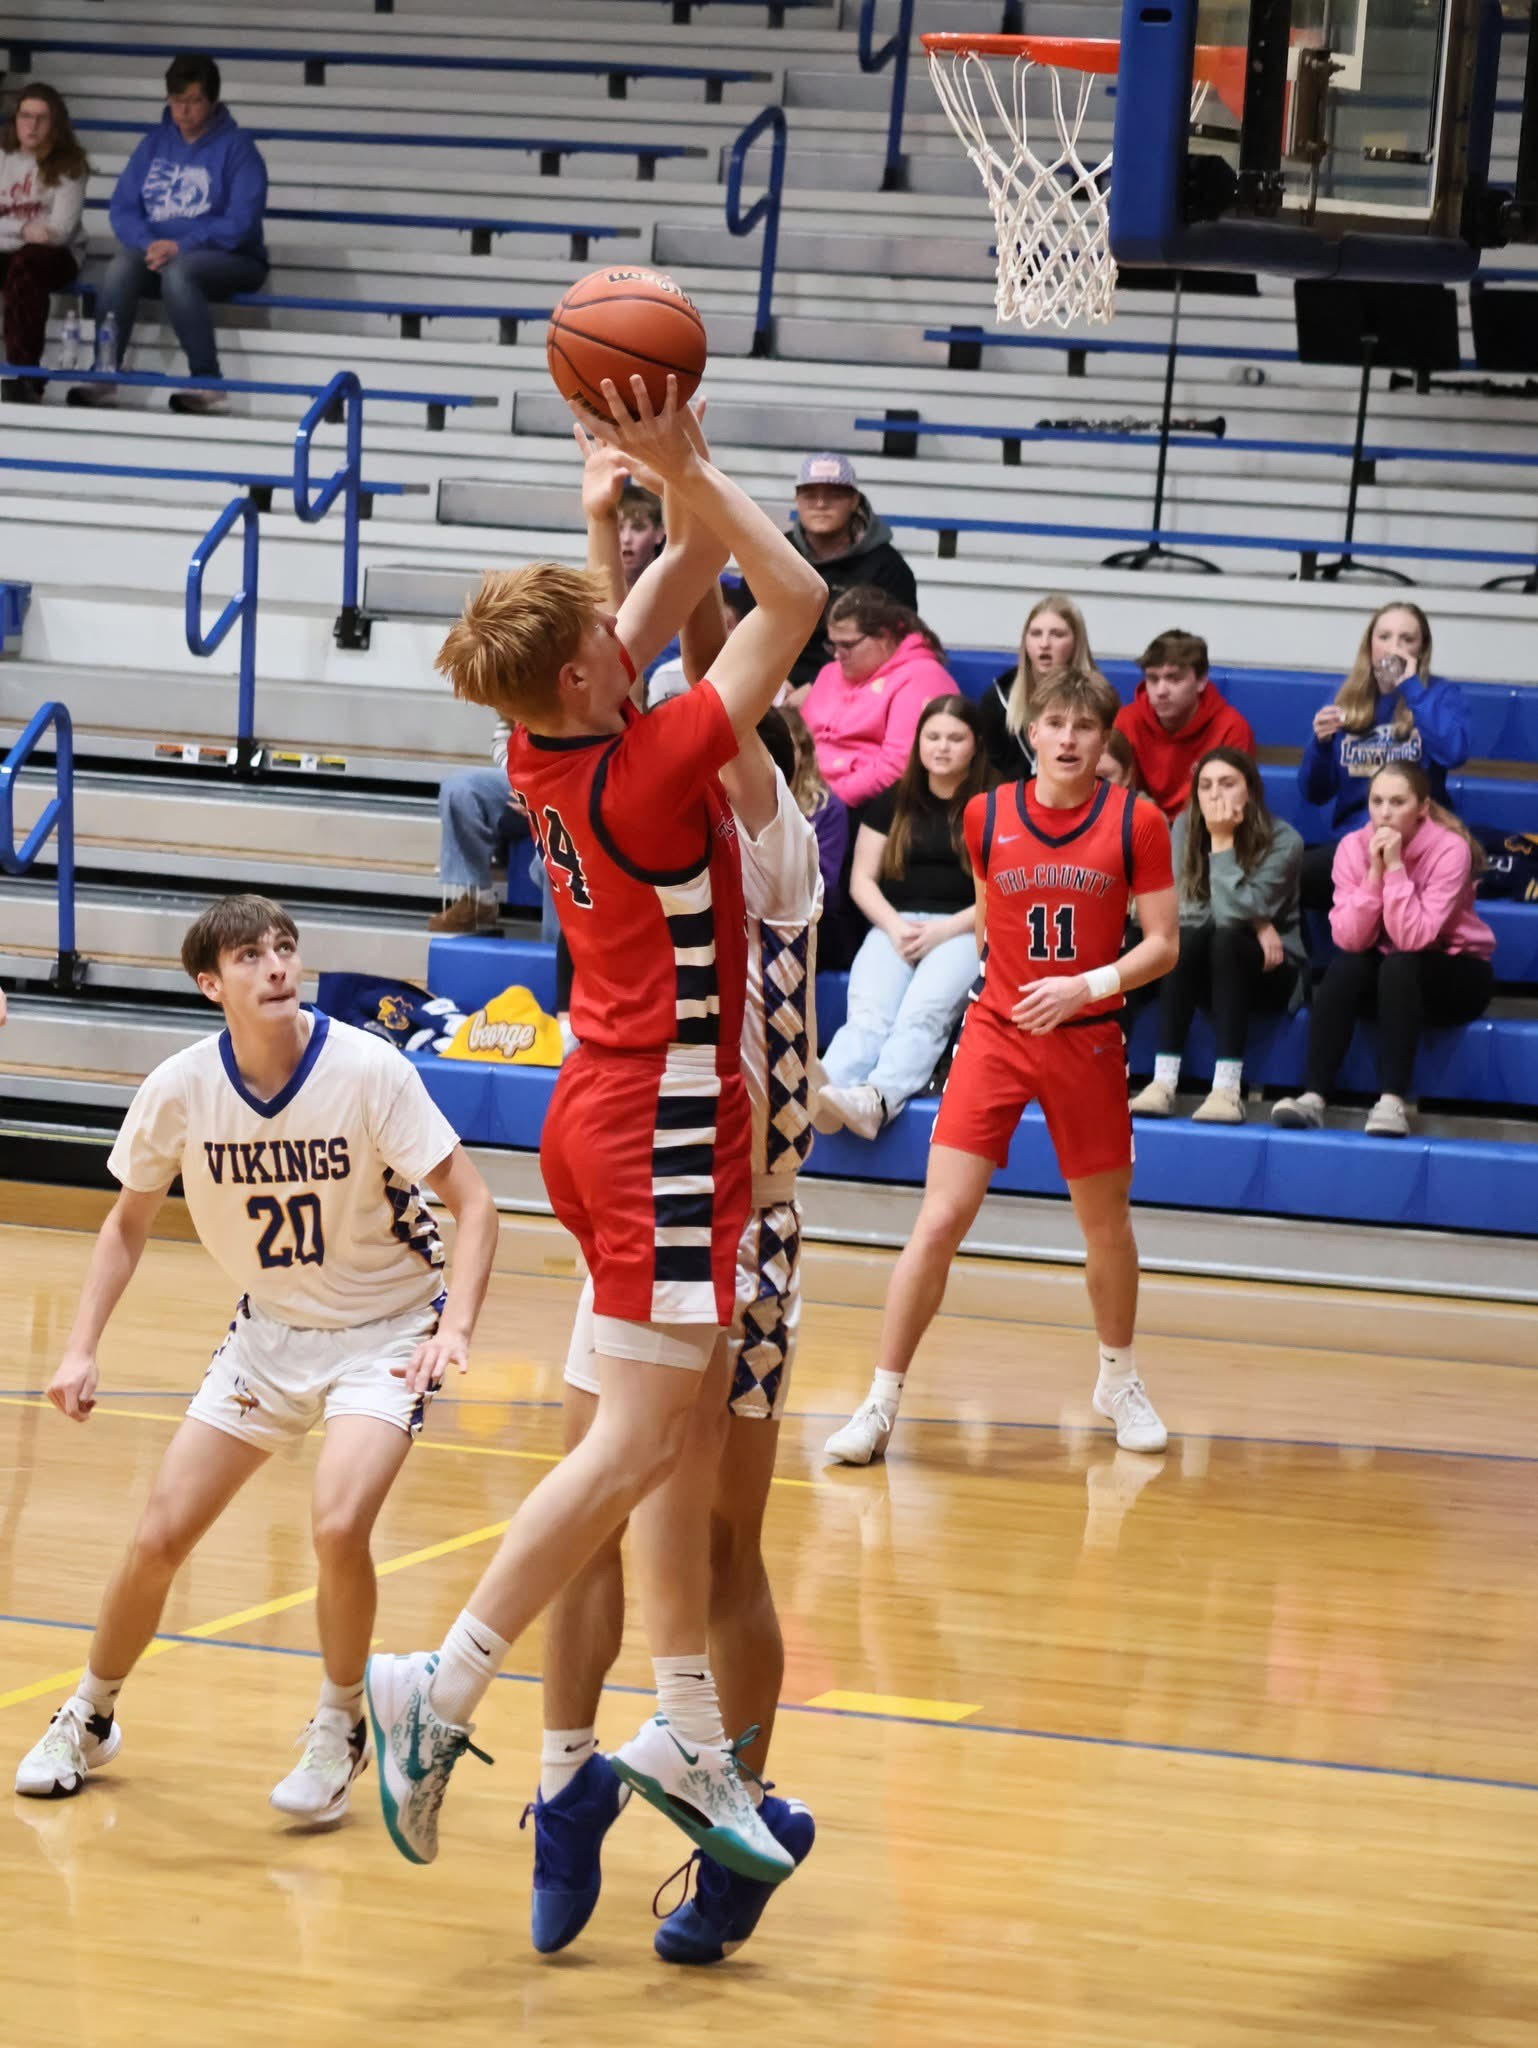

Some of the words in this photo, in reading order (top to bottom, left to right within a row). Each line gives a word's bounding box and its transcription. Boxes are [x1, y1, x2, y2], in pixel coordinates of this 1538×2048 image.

[1340, 736, 1376, 767] LADY
[994, 863, 1117, 897] TRI-COUNTY
[1026, 904, 1077, 961] 11
[468, 1007, 536, 1058] George
[203, 1137, 350, 1184] VIKINGS
[246, 1192, 325, 1269] 20
